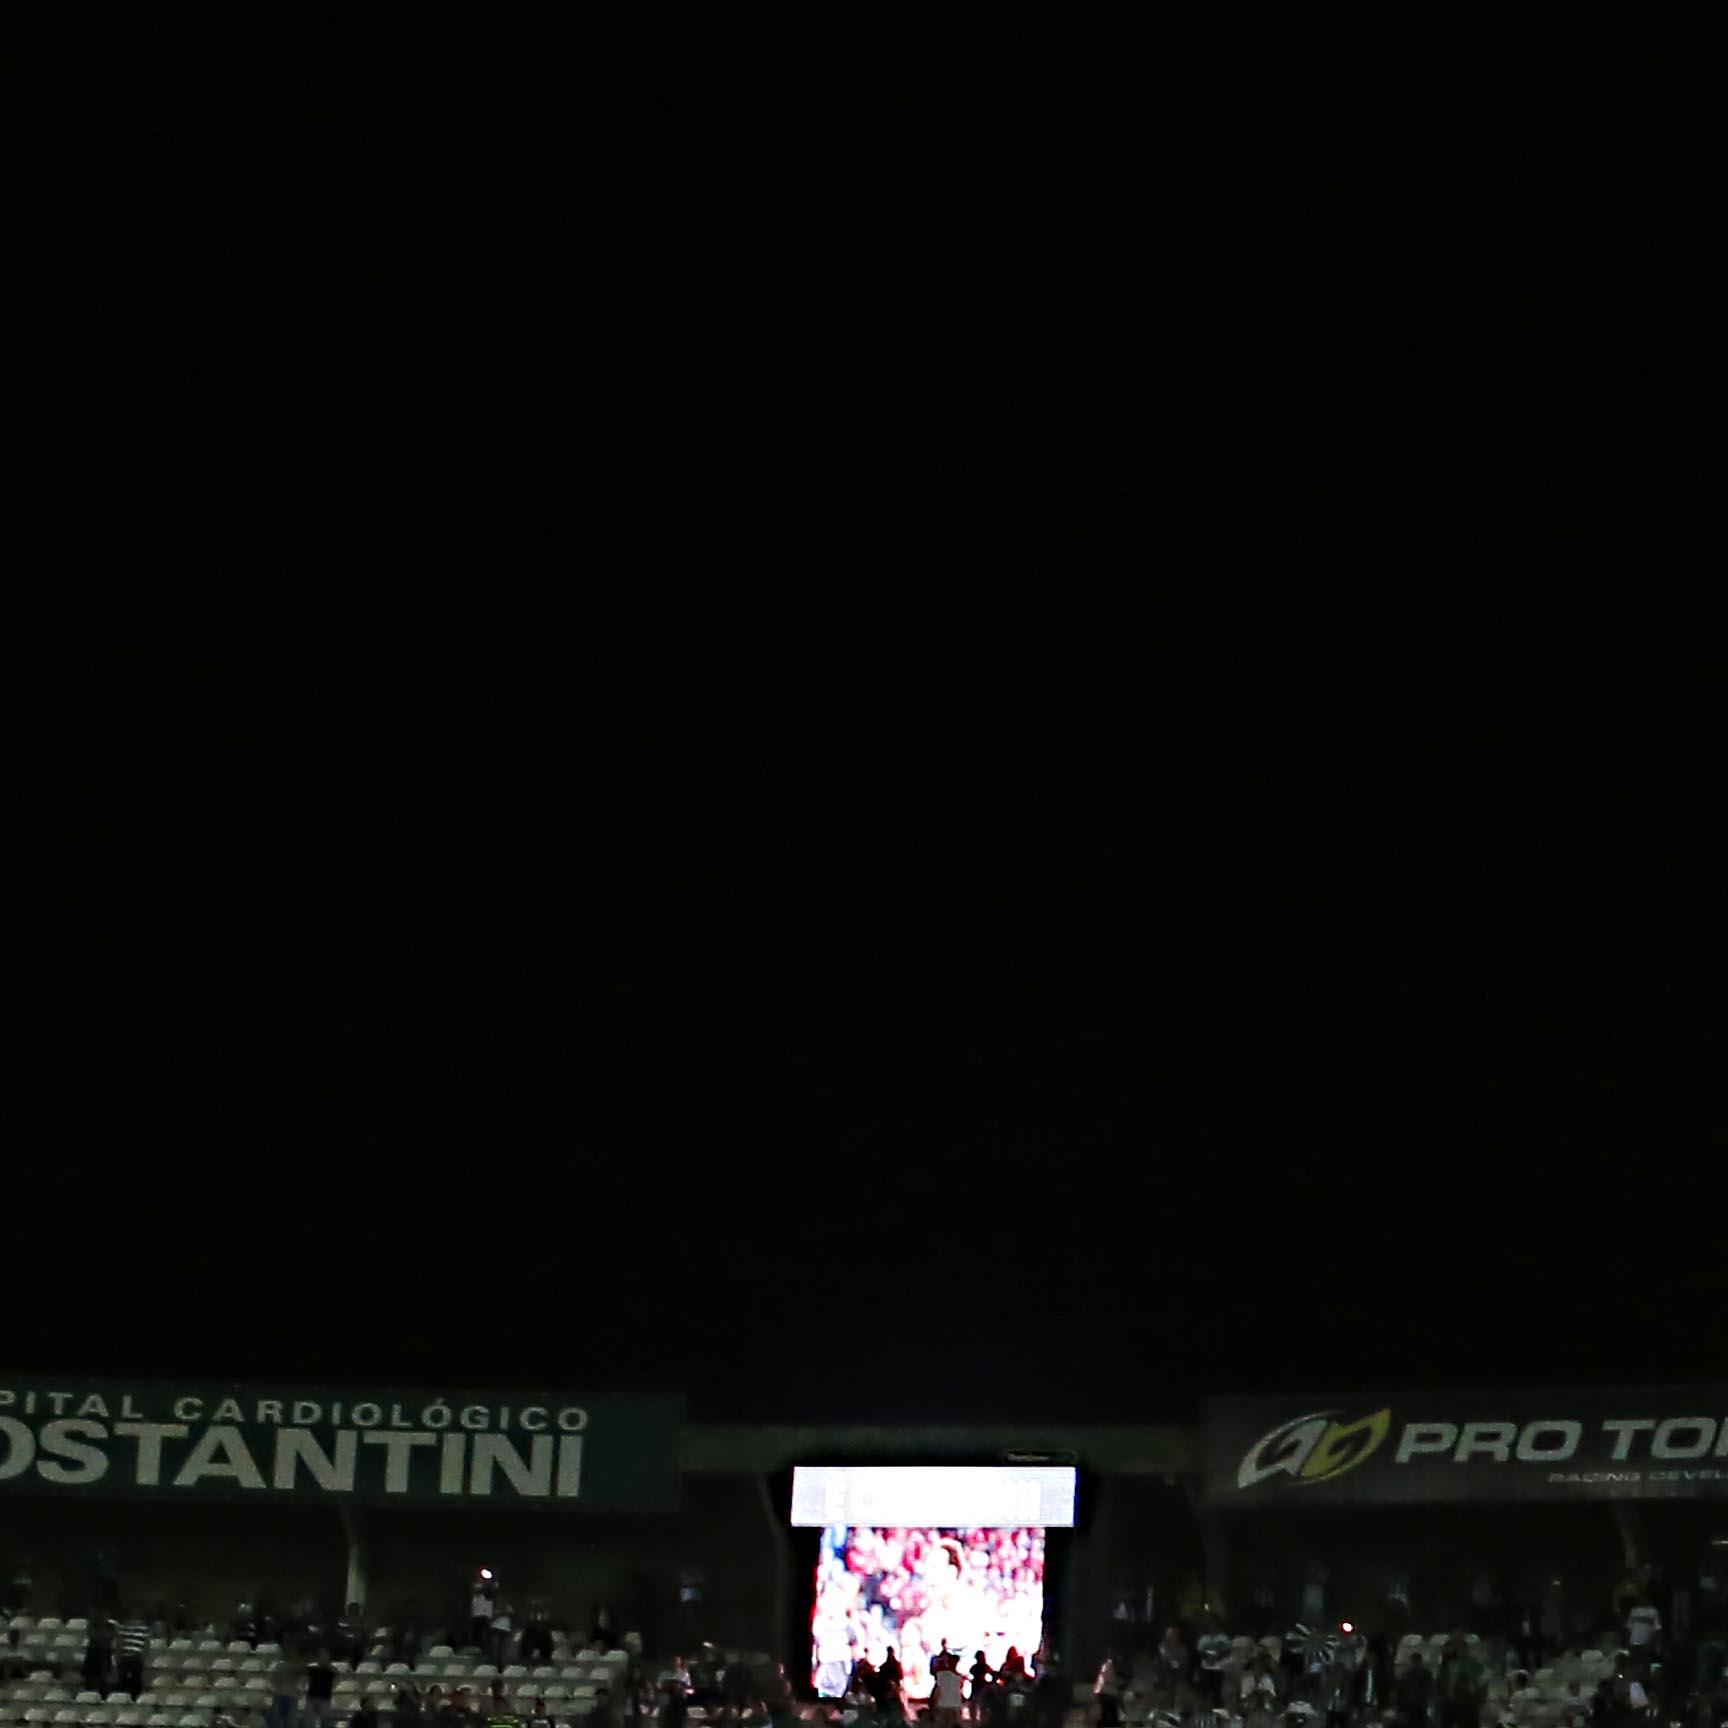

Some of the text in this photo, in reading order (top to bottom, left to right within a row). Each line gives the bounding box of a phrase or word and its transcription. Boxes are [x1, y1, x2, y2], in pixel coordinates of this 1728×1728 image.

[174, 1398, 589, 1431] CARDIOLÓGICO
[1394, 1419, 1582, 1464] PRO
[1549, 1472, 1641, 1483] RACING
